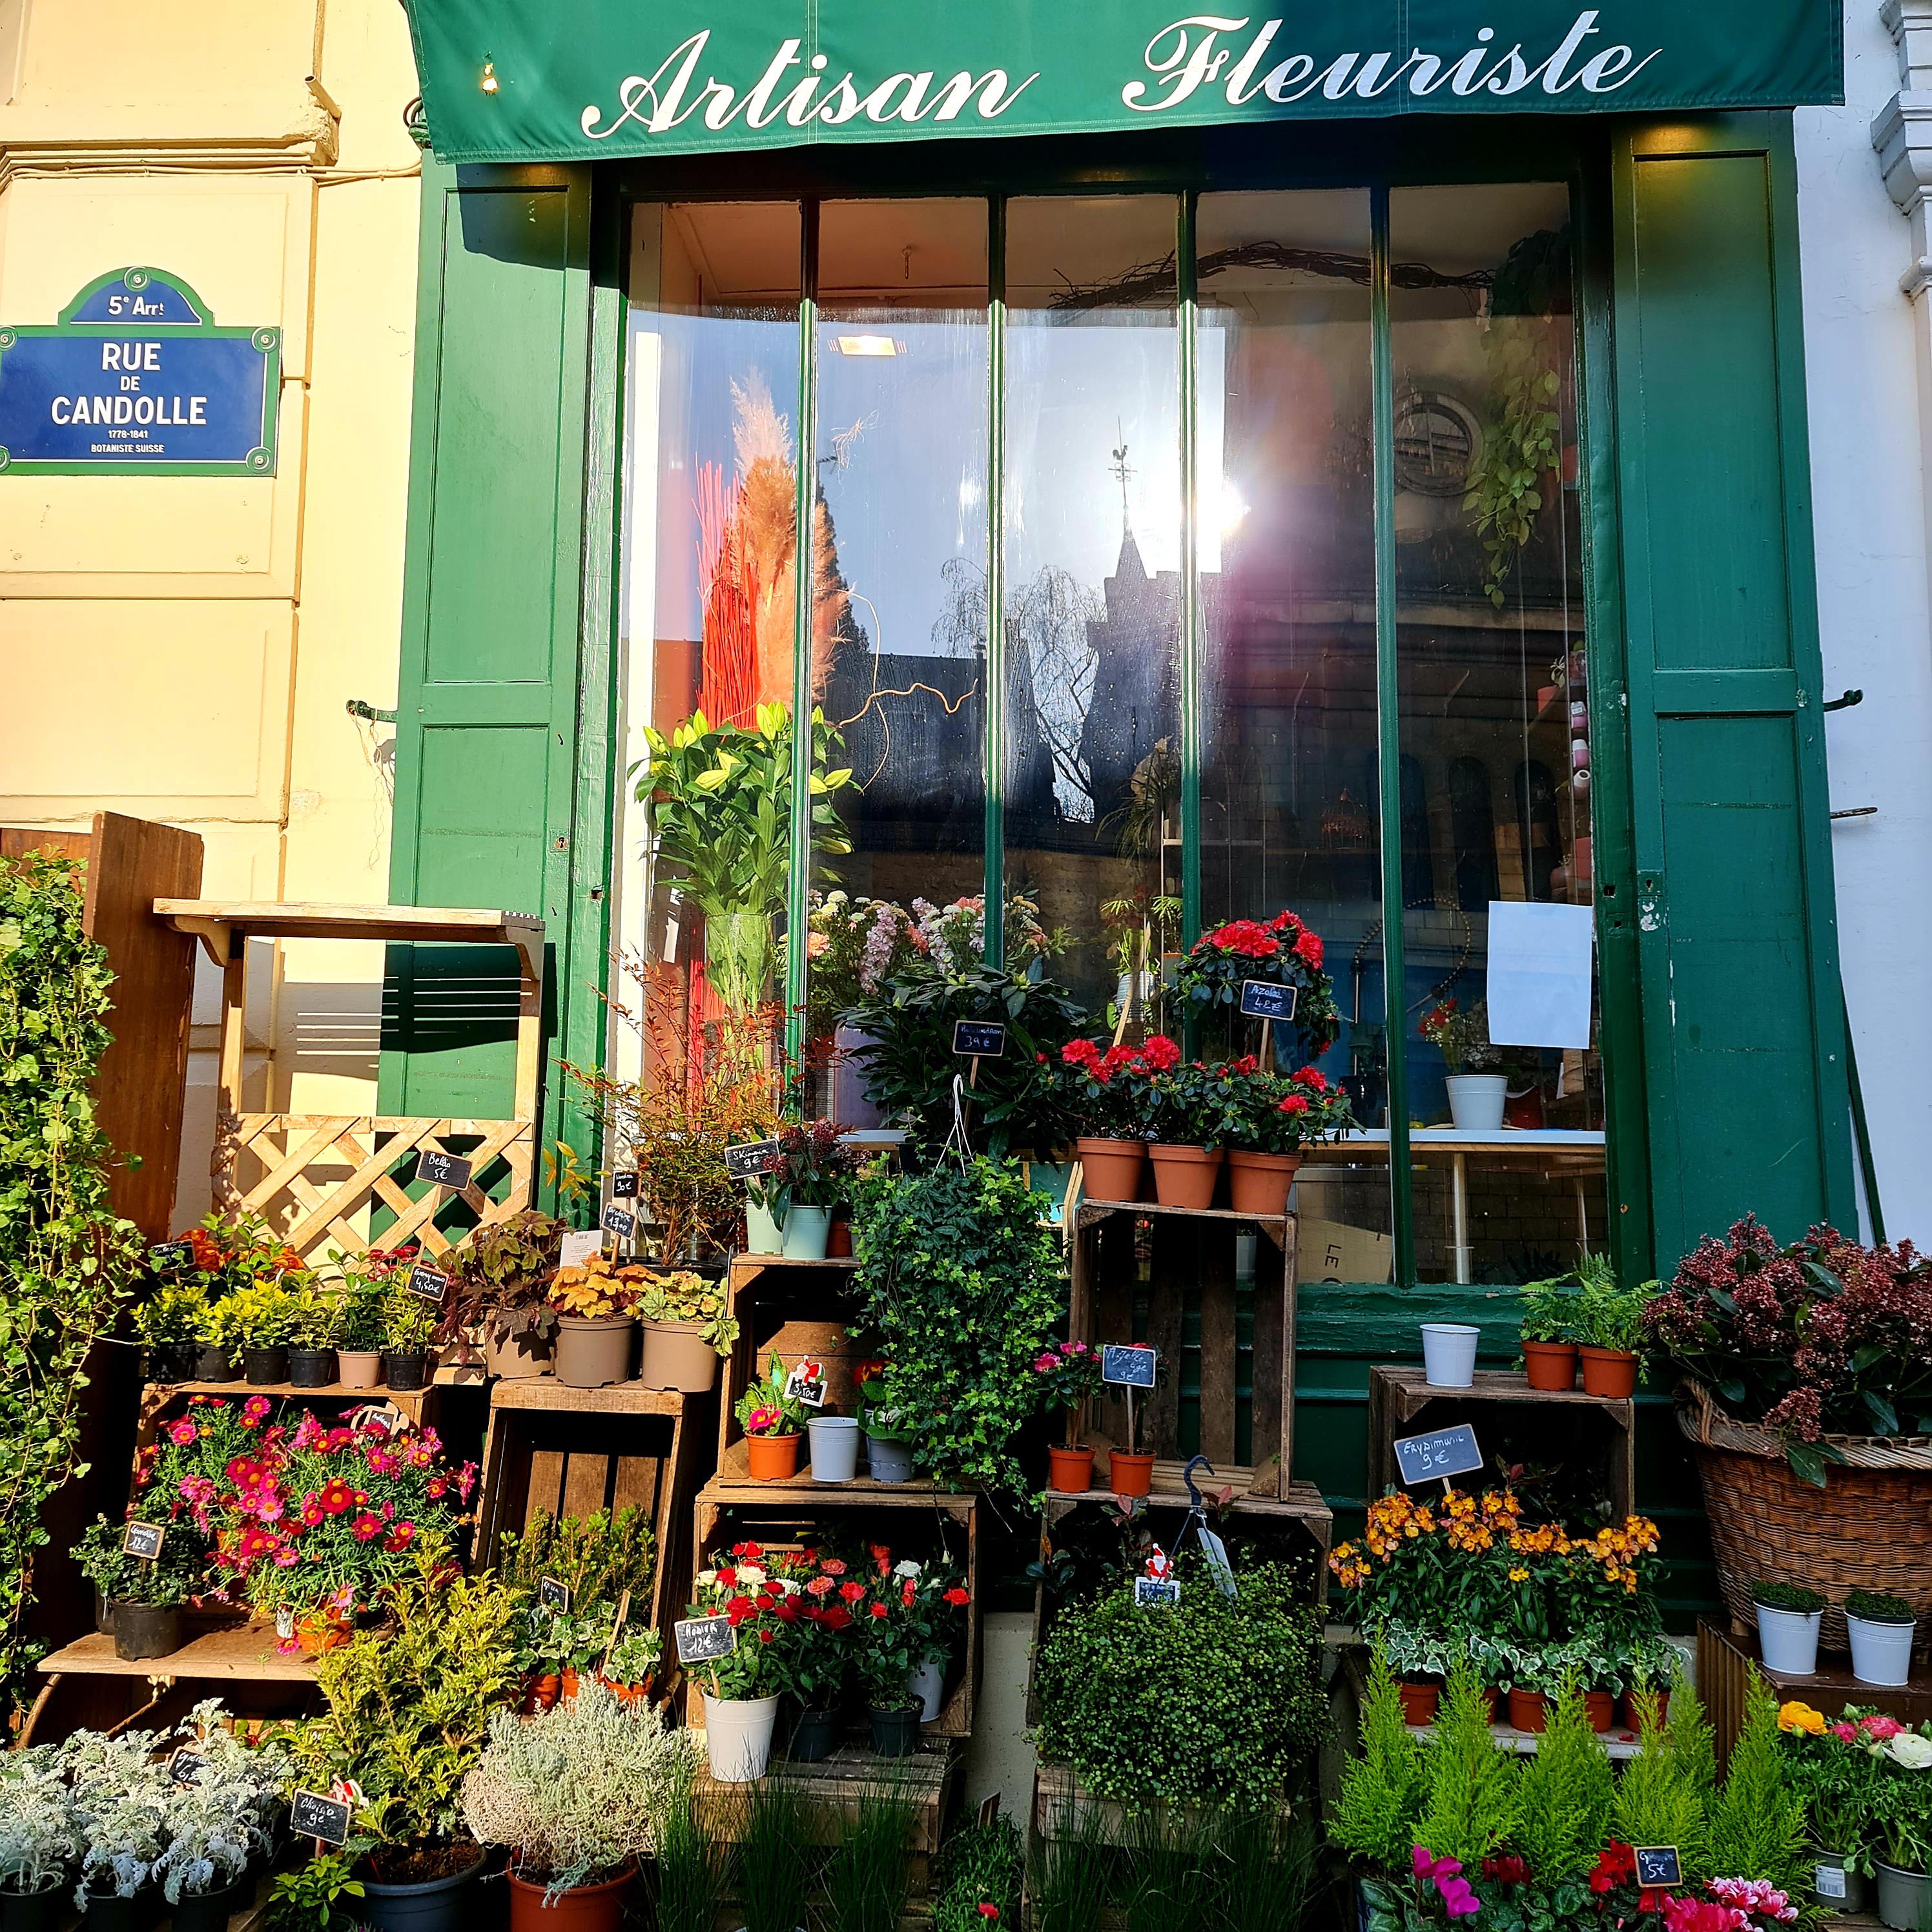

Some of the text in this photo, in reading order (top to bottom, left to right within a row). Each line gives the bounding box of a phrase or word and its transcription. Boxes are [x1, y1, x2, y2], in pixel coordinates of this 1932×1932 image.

[581, 10, 1663, 139] Artisan Fleuriste
[102, 342, 161, 371] RUE
[120, 376, 140, 391] DE
[51, 396, 207, 426] CANDOLLE
[108, 429, 148, 439] 1778-1841
[91, 444, 165, 453] BOTANISTE SUISSE
[686, 1634, 713, 1654] 12€
